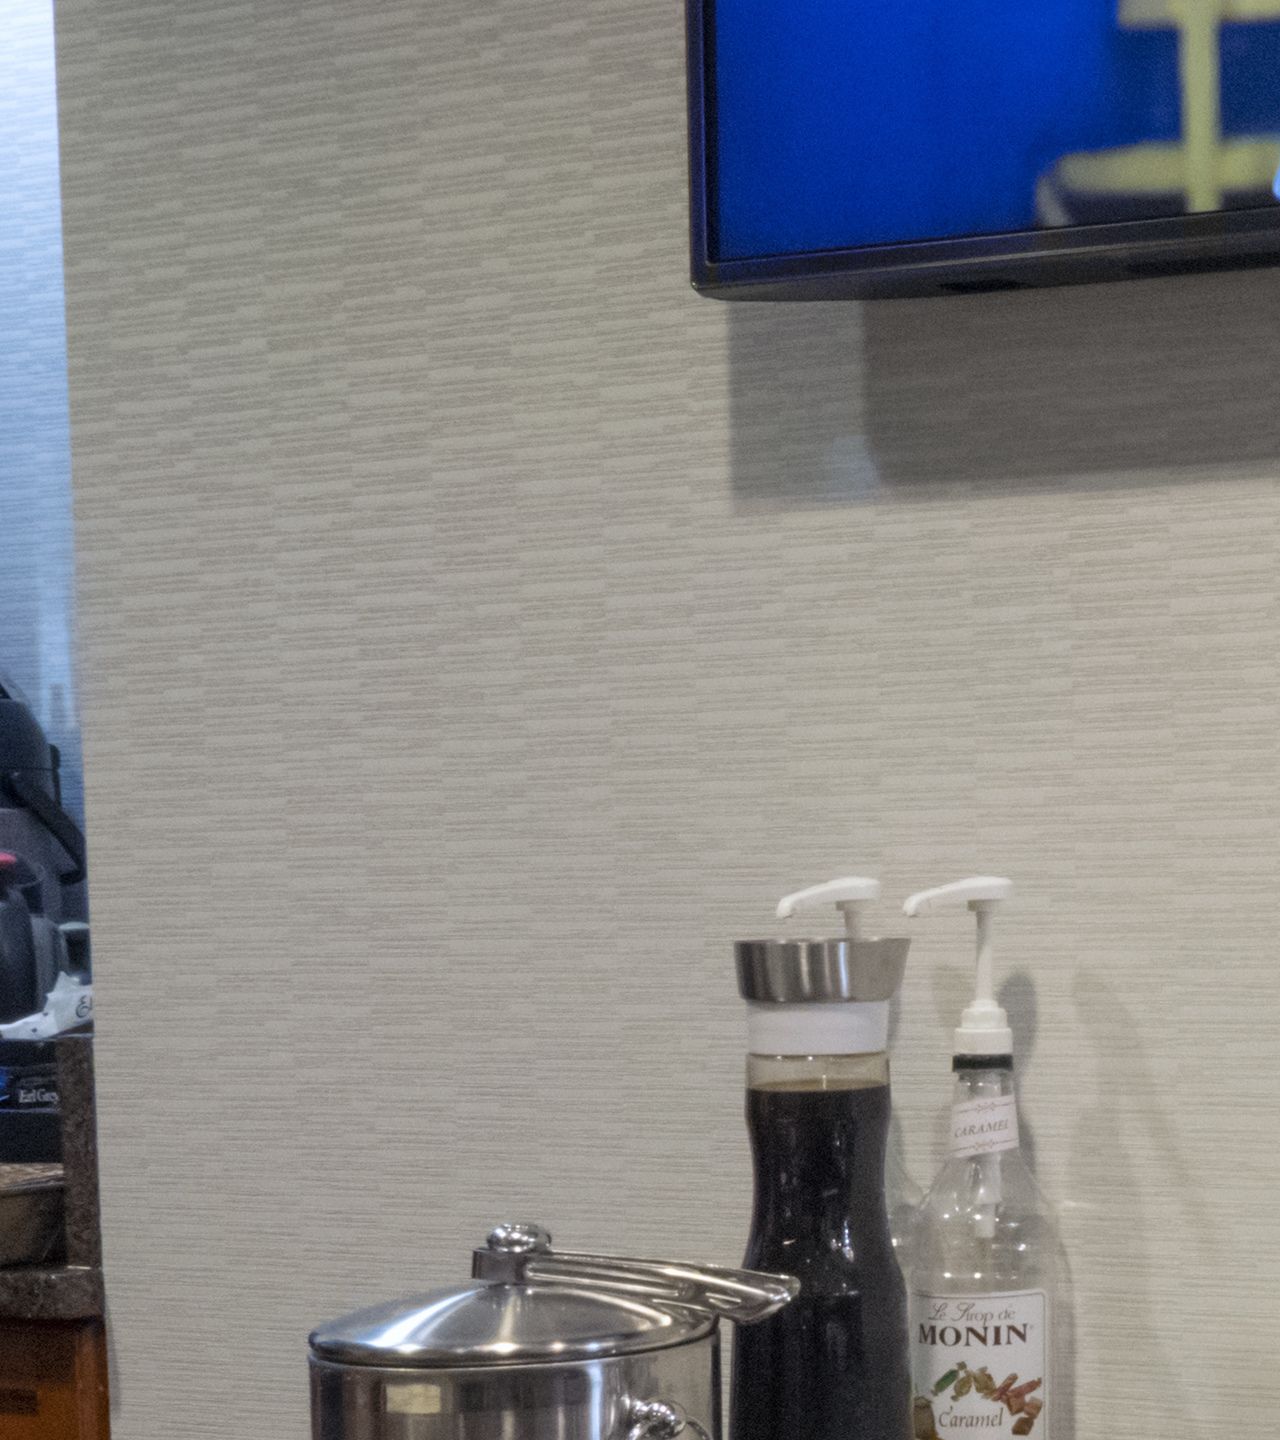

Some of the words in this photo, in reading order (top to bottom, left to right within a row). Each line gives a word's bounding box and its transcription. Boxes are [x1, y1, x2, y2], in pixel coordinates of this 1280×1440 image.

[954, 1118, 1009, 1138] CARAMEL
[928, 1302, 948, 1321] Le
[951, 1302, 994, 1326] Sirop
[998, 1308, 1016, 1320] de
[918, 1323, 1028, 1347] MONIN
[938, 1405, 1004, 1428] Caramel
